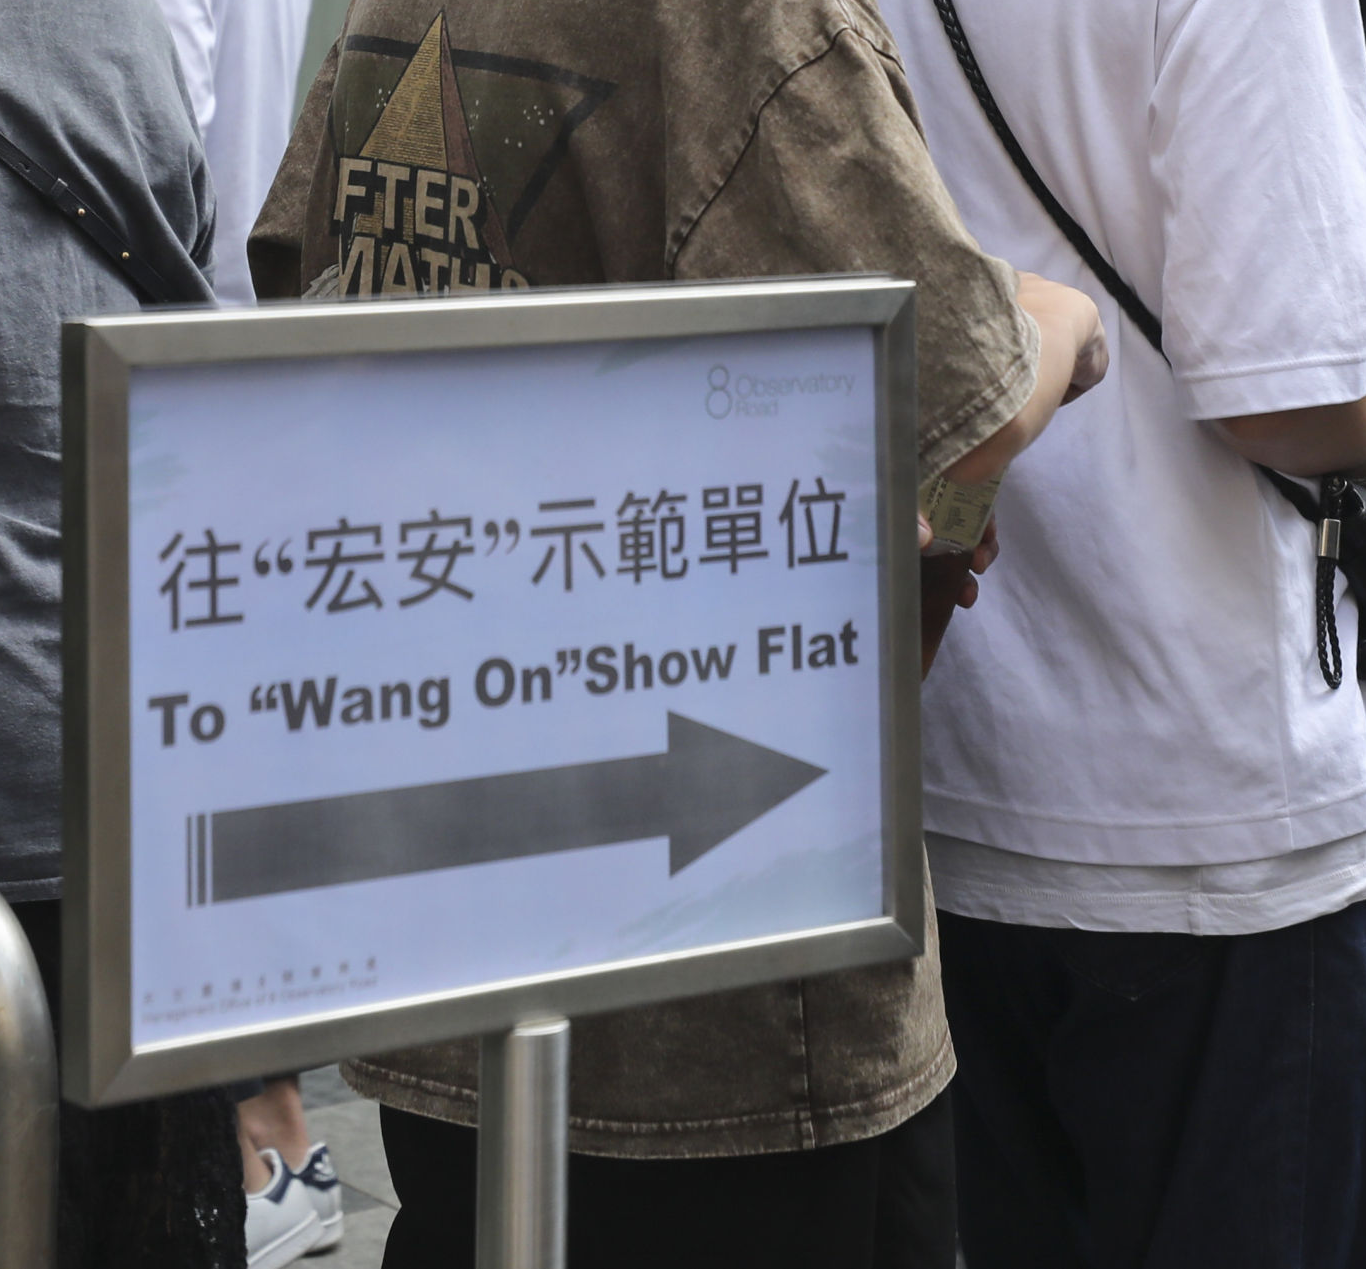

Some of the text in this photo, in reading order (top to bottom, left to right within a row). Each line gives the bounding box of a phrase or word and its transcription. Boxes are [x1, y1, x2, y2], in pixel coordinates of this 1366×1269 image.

[158, 477, 849, 632] 往“宏安”示範單位
[148, 694, 225, 748] To
[757, 620, 858, 675] Flat
